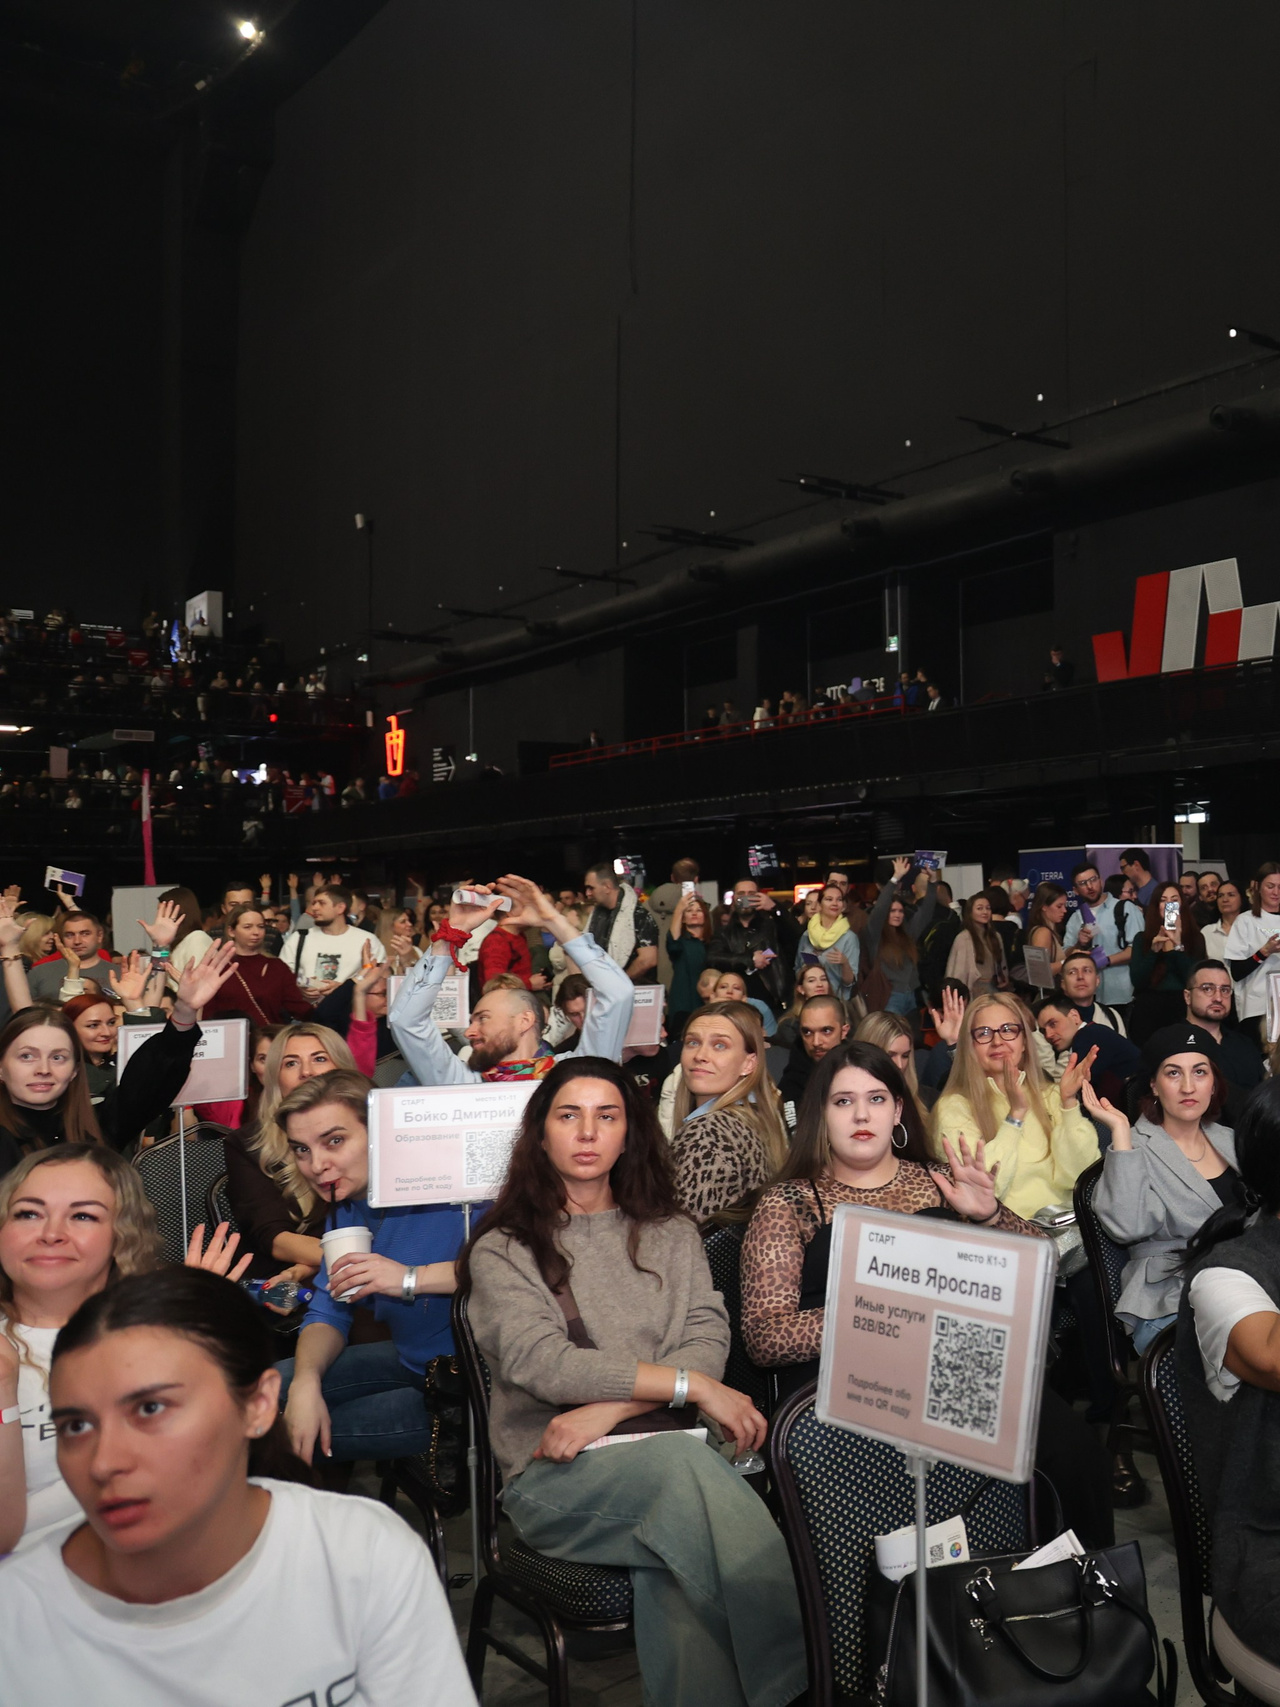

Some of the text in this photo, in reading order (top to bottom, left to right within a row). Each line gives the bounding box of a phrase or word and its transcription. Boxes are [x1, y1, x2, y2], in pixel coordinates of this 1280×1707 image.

[1040, 871, 1064, 880] TERRA
[404, 1108, 516, 1123] Бойко Дмитрий
[395, 1132, 460, 1143] Образование
[395, 1176, 436, 1185] Подробнее
[868, 1231, 896, 1246] СТАРТ
[957, 1251, 1007, 1268] место К1-3
[868, 1256, 1002, 1301] Алиев Ярослав
[855, 1295, 926, 1324] Иные услуги
[853, 1315, 900, 1339] B2B/B2C
[848, 1374, 911, 1401] Подробнее обо
[847, 1392, 911, 1419] мне по QR коду
